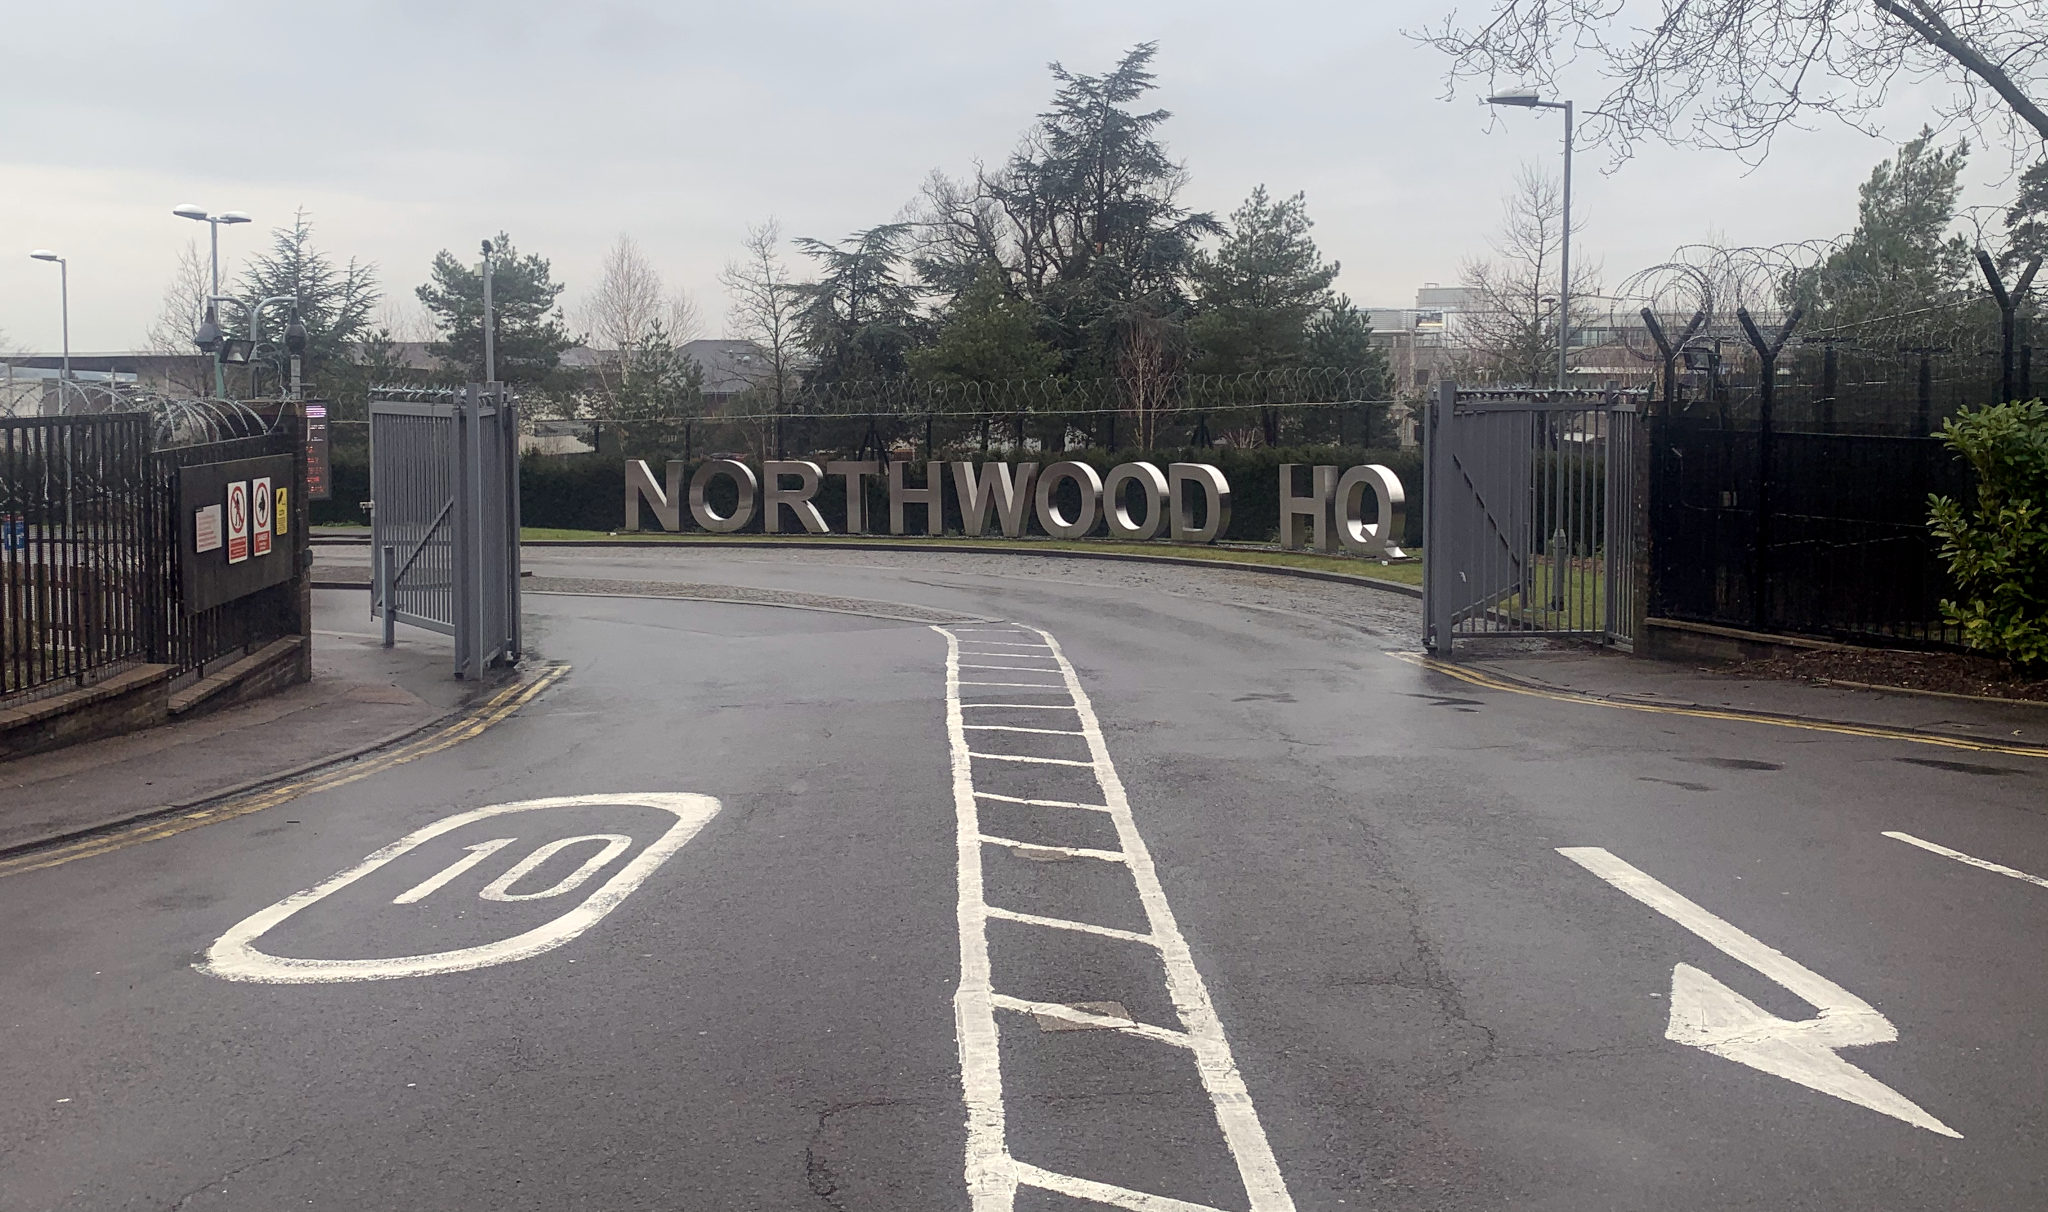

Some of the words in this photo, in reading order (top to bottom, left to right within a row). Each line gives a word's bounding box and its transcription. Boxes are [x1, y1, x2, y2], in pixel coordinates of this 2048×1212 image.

[624, 459, 1231, 543] NORTHWOOD
[1279, 463, 1406, 558] HQ
[392, 833, 633, 905] 10
